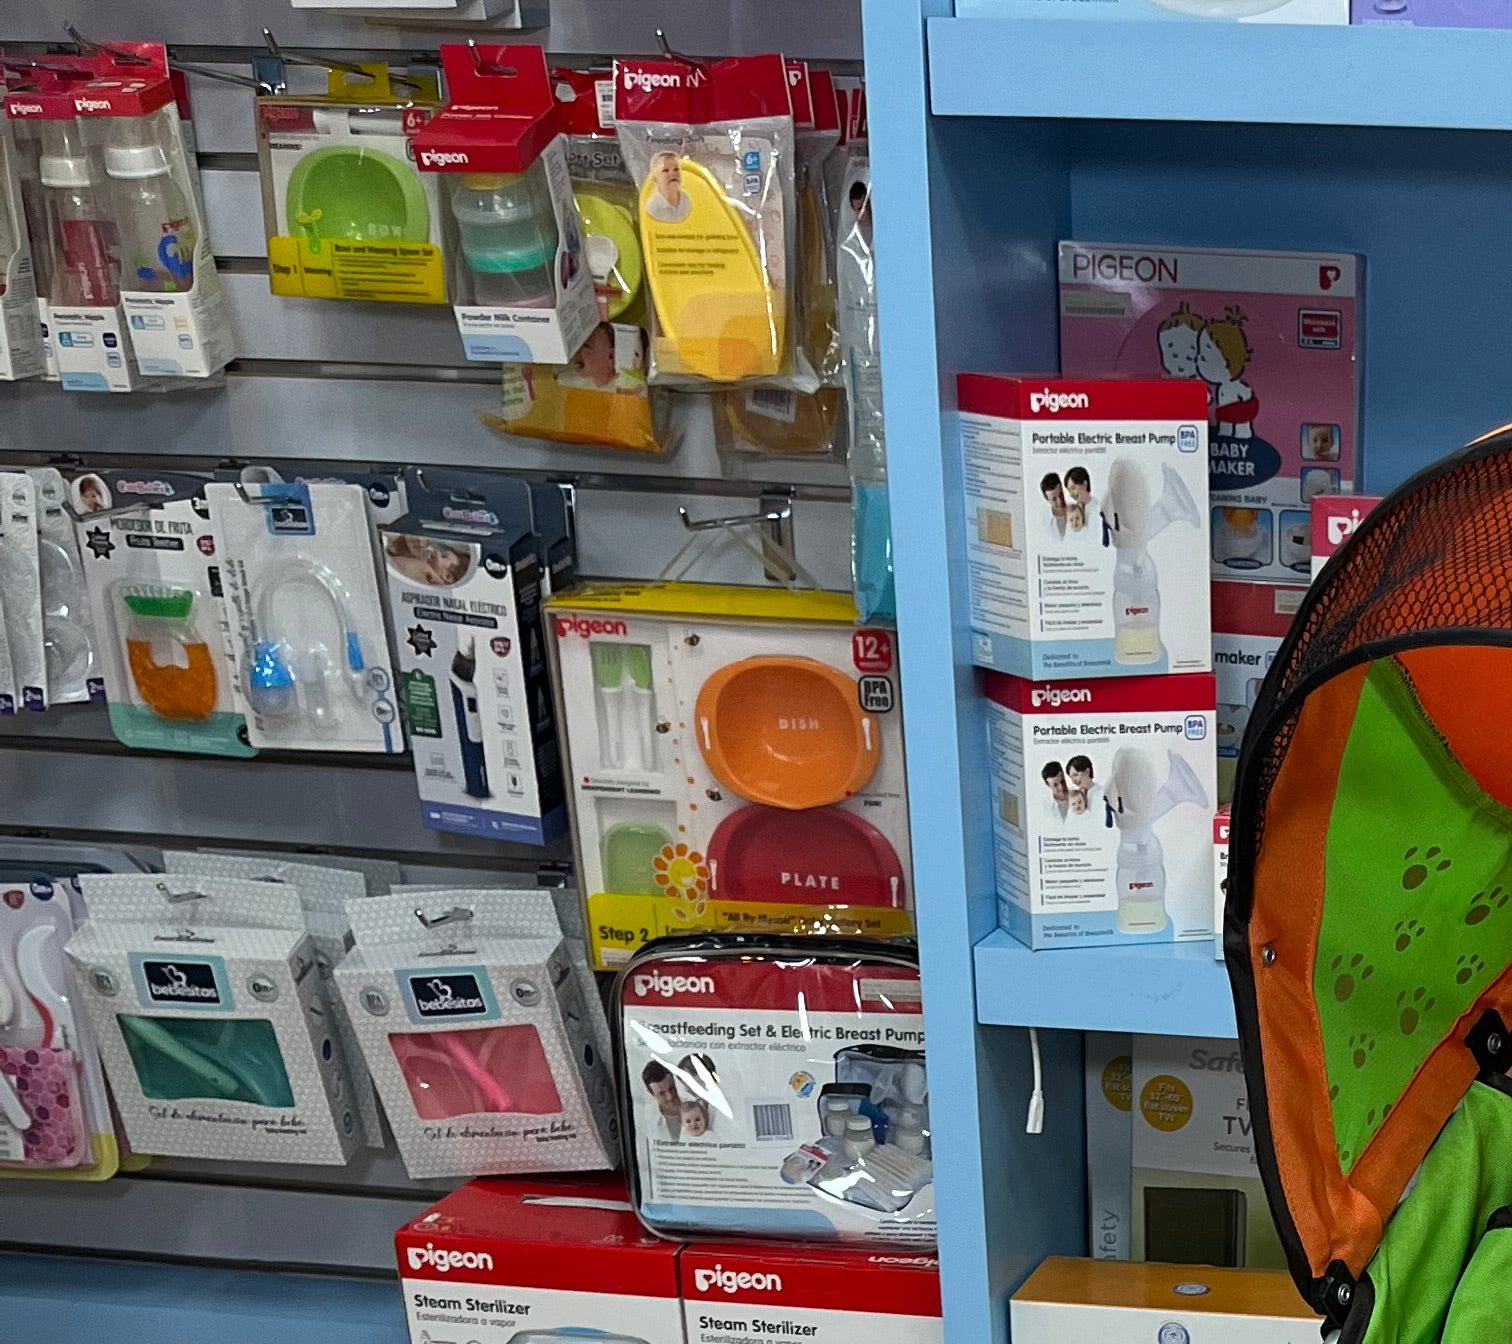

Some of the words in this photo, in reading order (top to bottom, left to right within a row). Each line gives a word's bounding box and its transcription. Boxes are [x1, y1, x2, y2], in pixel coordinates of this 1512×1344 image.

[624, 69, 681, 92] pigeon
[10, 103, 43, 116] pigeon
[75, 97, 111, 112] pigeon
[406, 113, 423, 128] 6+
[421, 149, 469, 167] pigeon
[1072, 253, 1178, 283] PIGEON
[461, 312, 492, 322] Powder
[494, 313, 511, 322] Milk
[512, 314, 551, 324] Container
[1030, 388, 1089, 412] pigeon
[1032, 432, 1075, 445] Portable
[1078, 432, 1113, 445] Electric
[1115, 433, 1147, 444] Breast
[1149, 433, 1176, 446] Pump
[1210, 443, 1249, 457] BABY
[556, 613, 628, 638] pigeon
[854, 635, 890, 659] 12+
[1214, 651, 1262, 666] maker
[863, 680, 888, 695] BPA
[1031, 685, 1092, 707] pigeon
[863, 693, 890, 708] Free
[778, 717, 820, 731] DISH
[1033, 723, 1077, 736] Portable
[1080, 723, 1116, 735] Electric
[1119, 724, 1151, 735] Breast
[1154, 723, 1183, 735] Pump
[1187, 719, 1203, 729] BPA
[781, 872, 840, 890] PLATE
[599, 925, 636, 945] Step
[639, 926, 650, 943] 2
[634, 969, 715, 998] pigeon
[740, 1024, 761, 1038] Set
[767, 1025, 777, 1038] &
[781, 1026, 832, 1040] Eletric
[835, 1027, 881, 1041] Breast
[886, 1029, 925, 1043] Pump
[1188, 1050, 1244, 1074] Saf
[1157, 1082, 1176, 1094] Fits
[1099, 1209, 1120, 1260] fety
[407, 1243, 494, 1272] pigeon
[695, 1264, 783, 1293] pigeon
[414, 1294, 462, 1310] Steam
[466, 1295, 531, 1316] Sterilizer
[416, 1311, 479, 1325] Esterilizadora
[490, 1319, 516, 1329] vapor
[699, 1316, 748, 1332] Steam
[752, 1319, 818, 1337] Sterilizer
